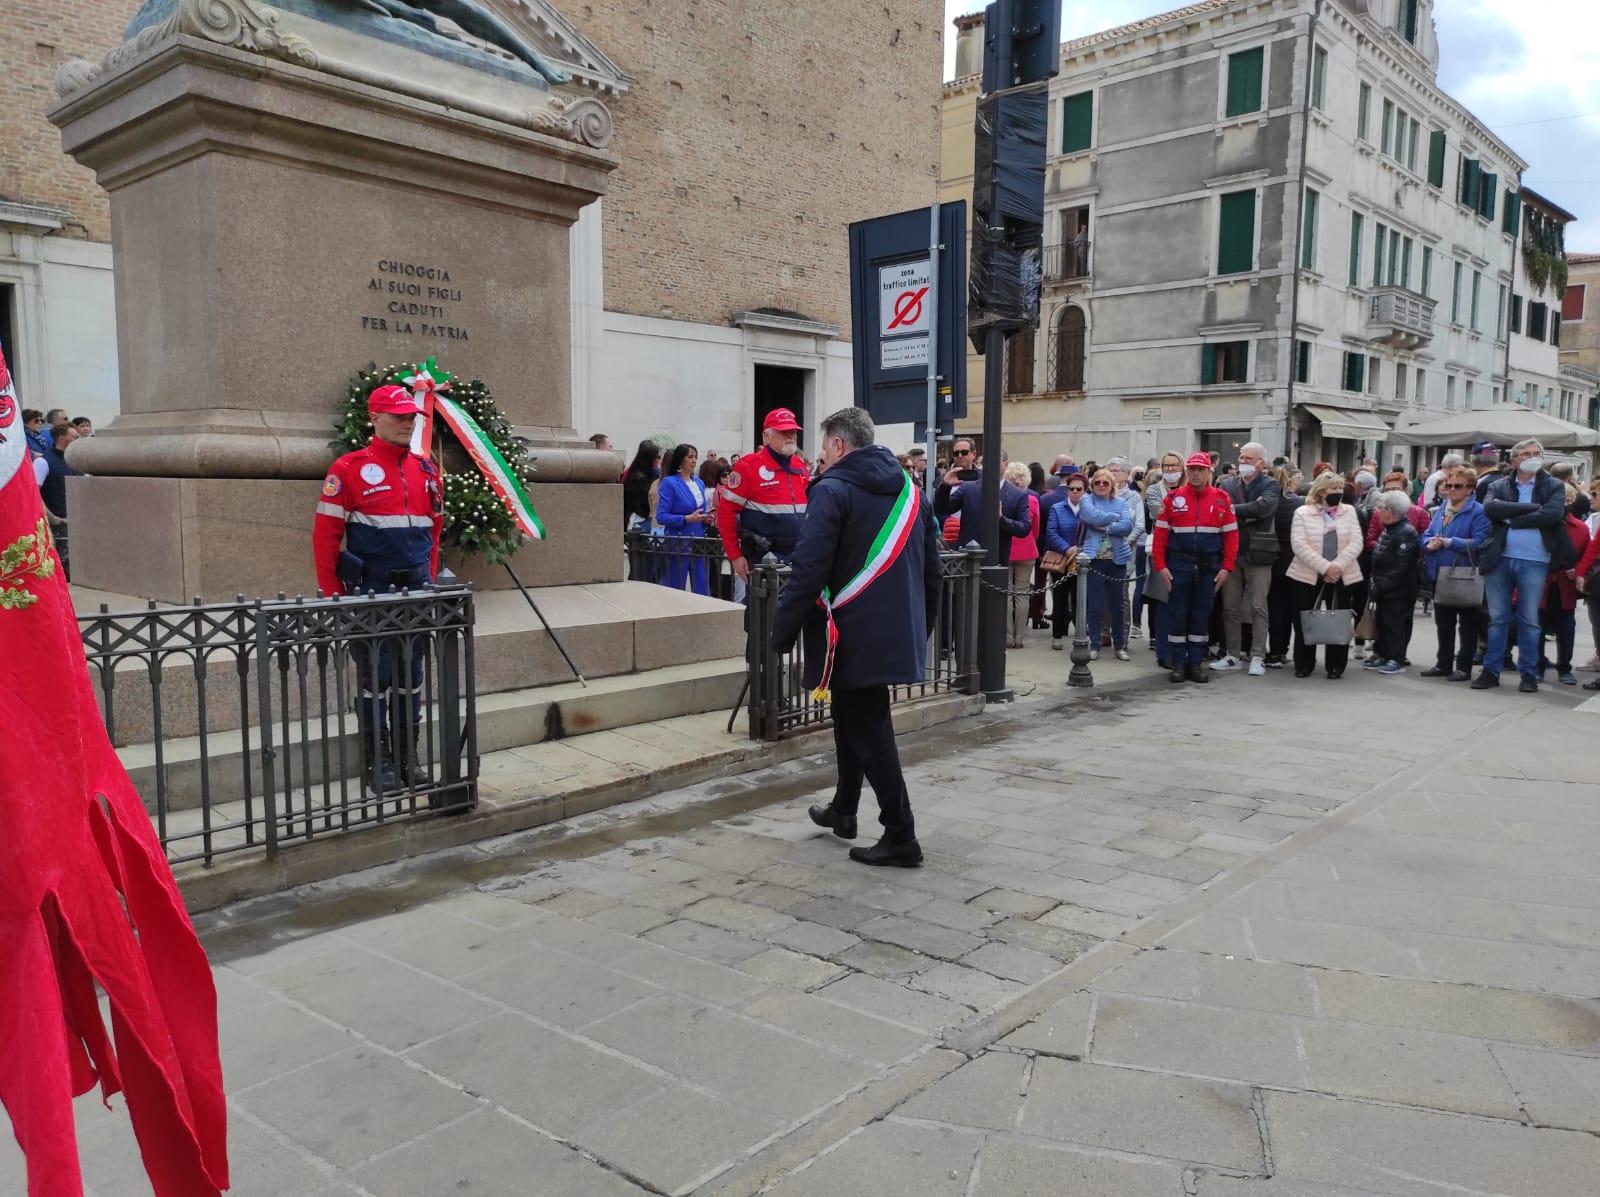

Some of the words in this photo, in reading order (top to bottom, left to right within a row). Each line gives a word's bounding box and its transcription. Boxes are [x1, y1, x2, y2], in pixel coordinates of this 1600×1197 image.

[378, 260, 451, 282] CHIOGGIA
[368, 278, 383, 290] AI
[388, 280, 422, 297] SUOI
[427, 286, 462, 302] FIGLI
[883, 280, 907, 290] traffico
[907, 276, 930, 287] limitat
[388, 301, 444, 318] CADUTI
[361, 316, 388, 332] PER
[396, 321, 413, 334] LA
[421, 323, 469, 341] PATRIA
